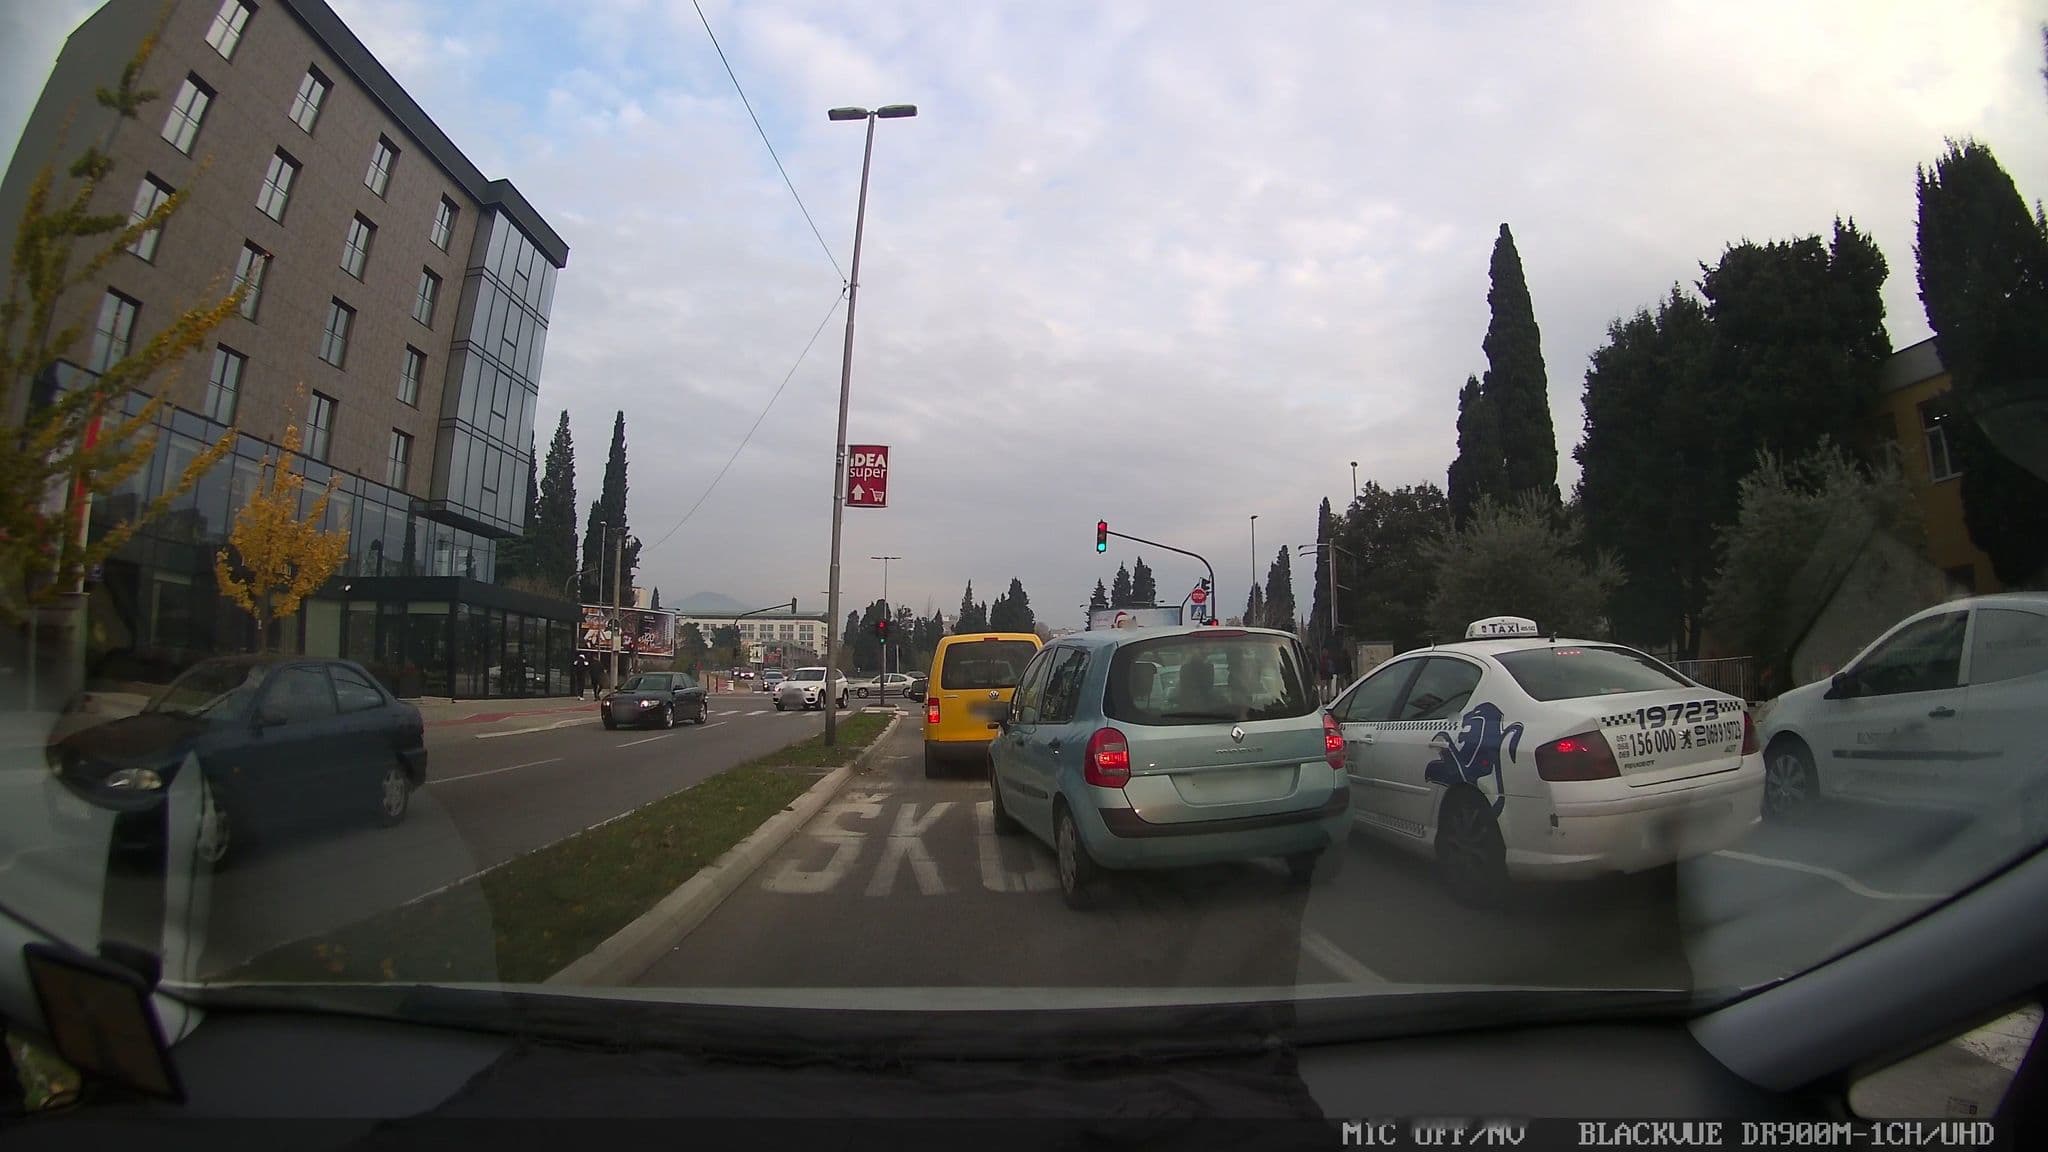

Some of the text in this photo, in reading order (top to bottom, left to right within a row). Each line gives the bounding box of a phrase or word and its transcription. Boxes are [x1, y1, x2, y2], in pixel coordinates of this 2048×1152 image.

[849, 467, 887, 481] super
[1489, 623, 1519, 634] TAXI
[1635, 700, 1719, 729] 19723
[1629, 728, 1676, 757] 156 000
